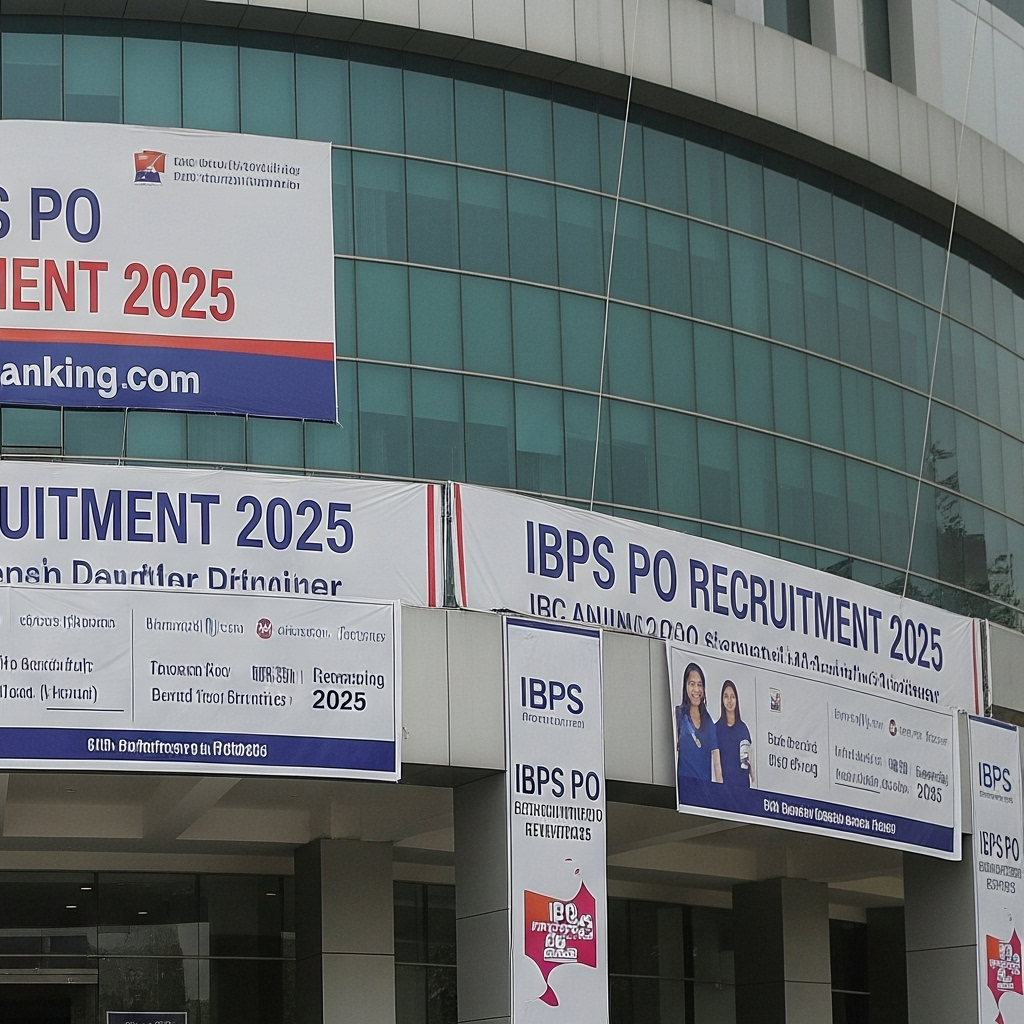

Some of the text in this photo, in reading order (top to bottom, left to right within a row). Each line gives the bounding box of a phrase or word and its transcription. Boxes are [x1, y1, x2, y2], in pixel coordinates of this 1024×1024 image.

[31, 187, 101, 244] PO
[124, 263, 236, 323] 2025
[236, 495, 356, 556] 2025
[526, 520, 616, 591] IBPS
[628, 543, 678, 603] PO
[689, 559, 883, 655] RECRUITMENT
[889, 615, 944, 672] 2025
[312, 689, 368, 712] 2025
[521, 676, 584, 715] IBPS
[515, 764, 600, 801] IBPS PO
[979, 761, 1012, 792] IBPS
[1005, 836, 1020, 861] PO
